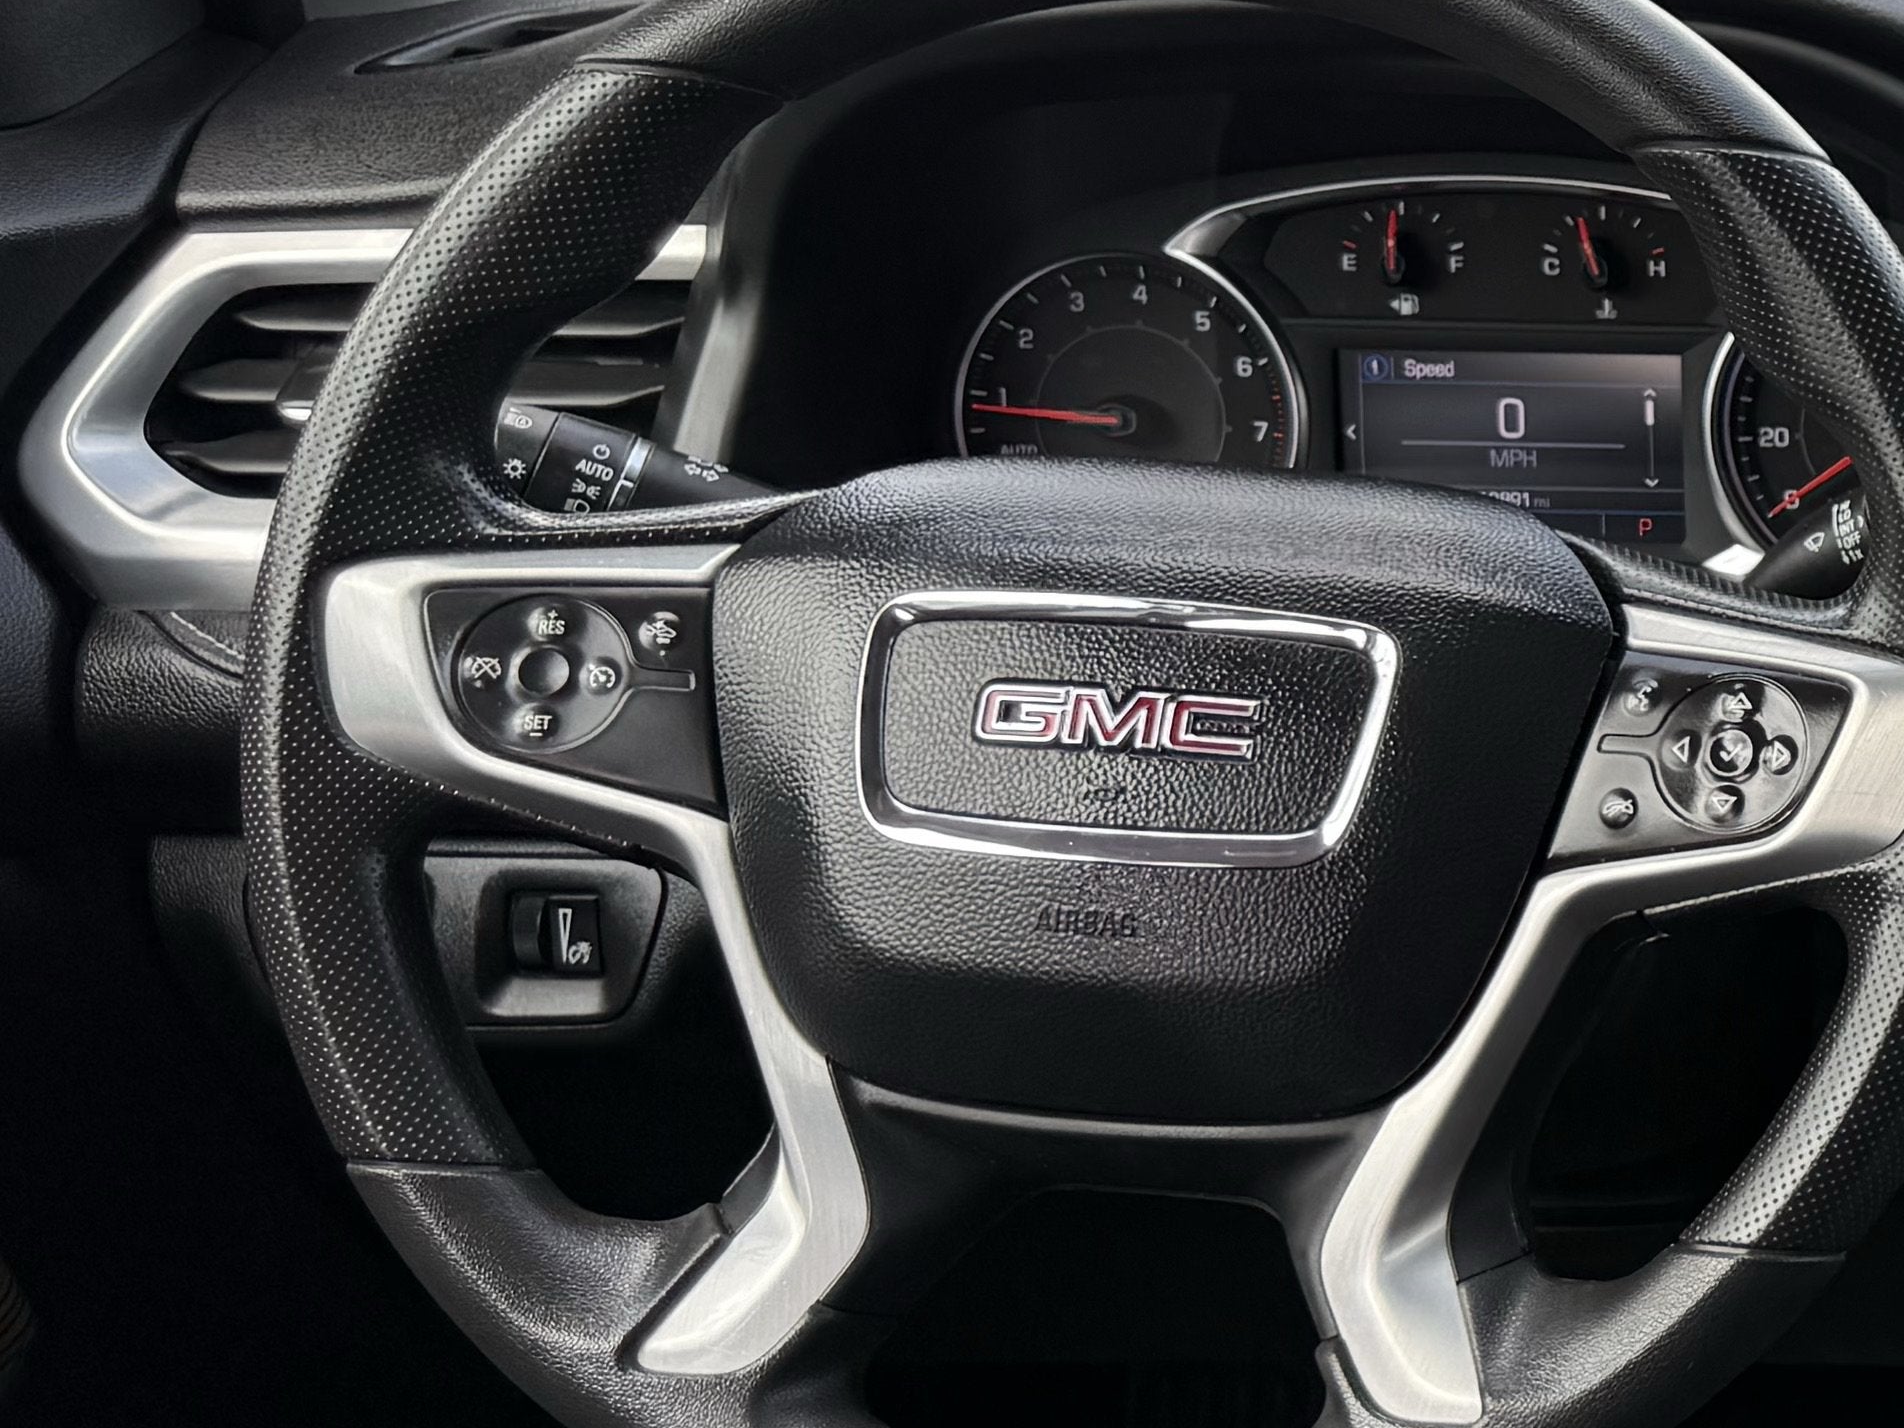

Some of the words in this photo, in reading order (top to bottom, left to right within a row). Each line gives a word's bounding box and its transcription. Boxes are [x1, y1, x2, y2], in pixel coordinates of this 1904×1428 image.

[1342, 253, 1358, 271] E
[1450, 255, 1464, 272] F
[1543, 257, 1560, 276] C
[1649, 259, 1666, 277] H
[1069, 291, 1085, 312] 3
[1132, 284, 1148, 305] 4
[1195, 311, 1211, 332] 5
[1018, 329, 1034, 349] 2
[1236, 356, 1253, 378] 6
[1404, 359, 1455, 379] Speed
[1498, 397, 1526, 439] 0
[1253, 421, 1269, 442] 7
[1758, 426, 1790, 448] 20
[1490, 449, 1537, 469] MPH
[575, 458, 614, 482] AUTO
[1638, 517, 1653, 537] P
[538, 620, 566, 635] RES
[524, 715, 552, 731] SET
[978, 684, 1258, 759] GMC
